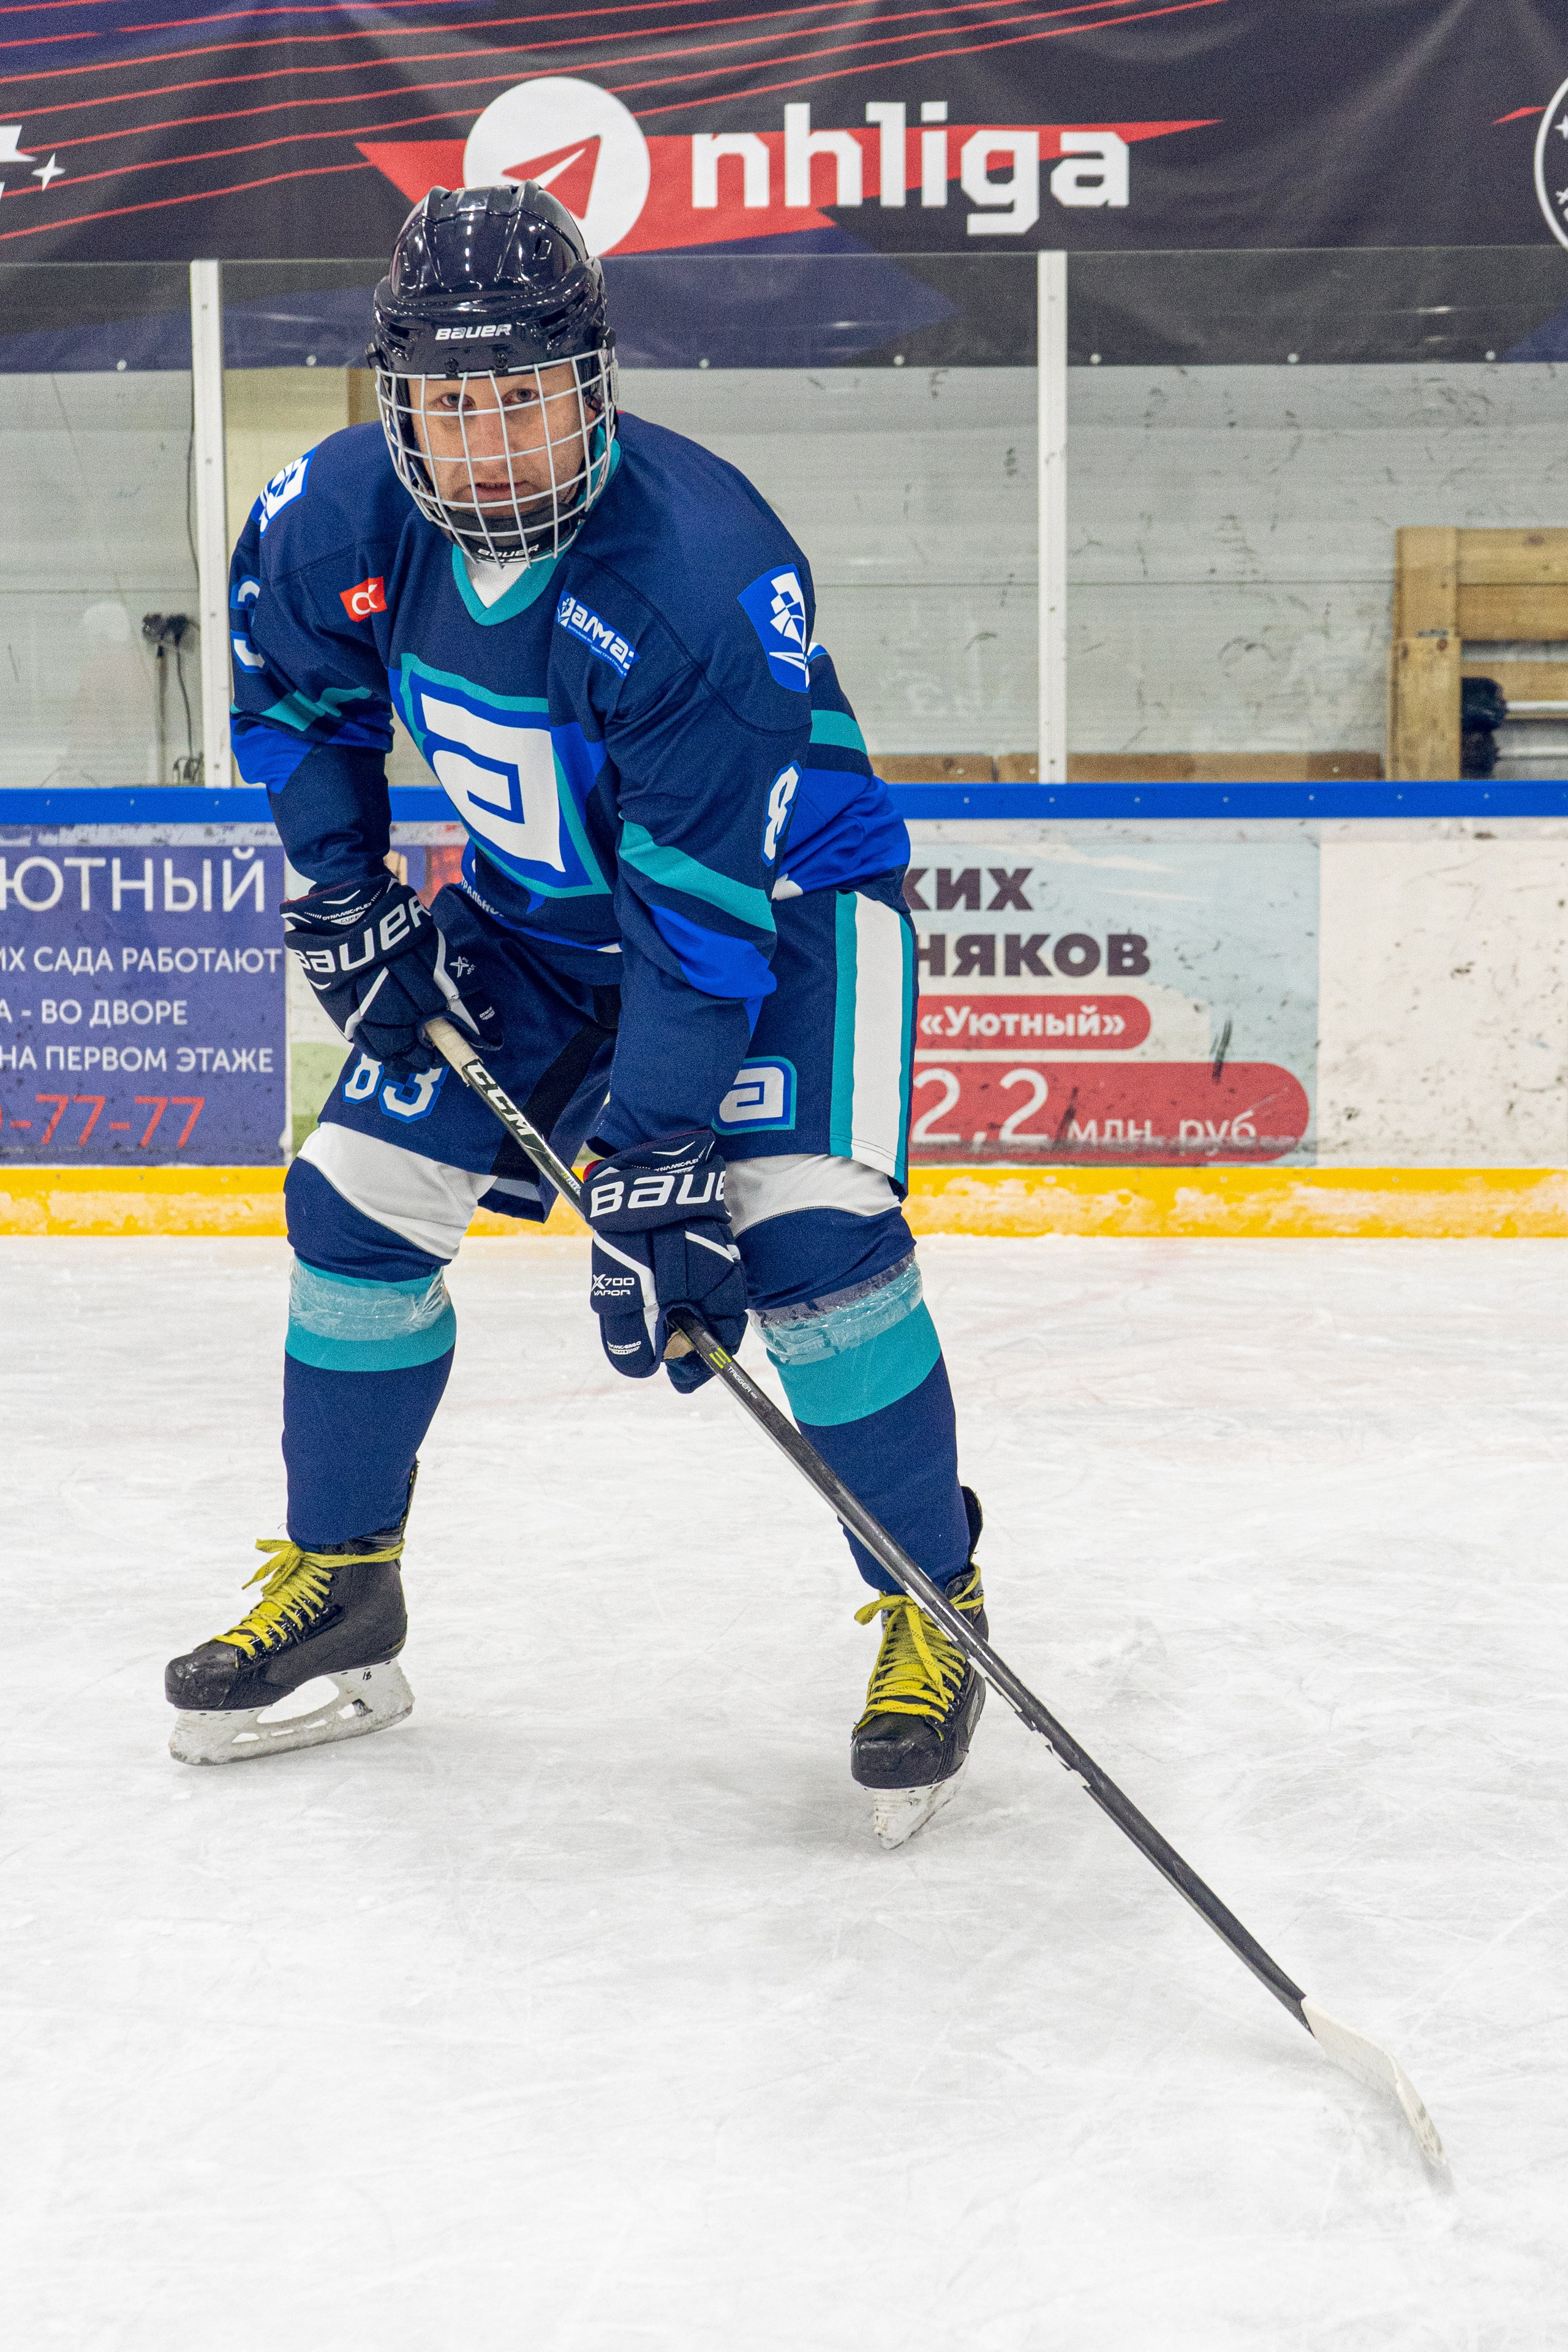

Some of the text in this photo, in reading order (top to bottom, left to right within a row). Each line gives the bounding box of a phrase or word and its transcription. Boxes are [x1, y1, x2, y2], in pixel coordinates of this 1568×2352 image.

[692, 102, 1129, 236] nhliga
[0, 847, 265, 912] ЮТНЫЙ
[34, 946, 114, 976] САДА
[123, 948, 282, 973] РАБОТАЮТ
[42, 999, 82, 1024] ВО
[89, 999, 188, 1028] ДВОРЕ
[920, 1005, 1126, 1037] «Уютный»
[0, 1046, 273, 1073] НА ПЕРВОМ ЭТАЖЕ
[467, 1061, 534, 1136] CCM
[0, 1093, 206, 1148] -77-77
[591, 1273, 635, 1292] X700
[728, 1365, 752, 1393] TRIGGER
